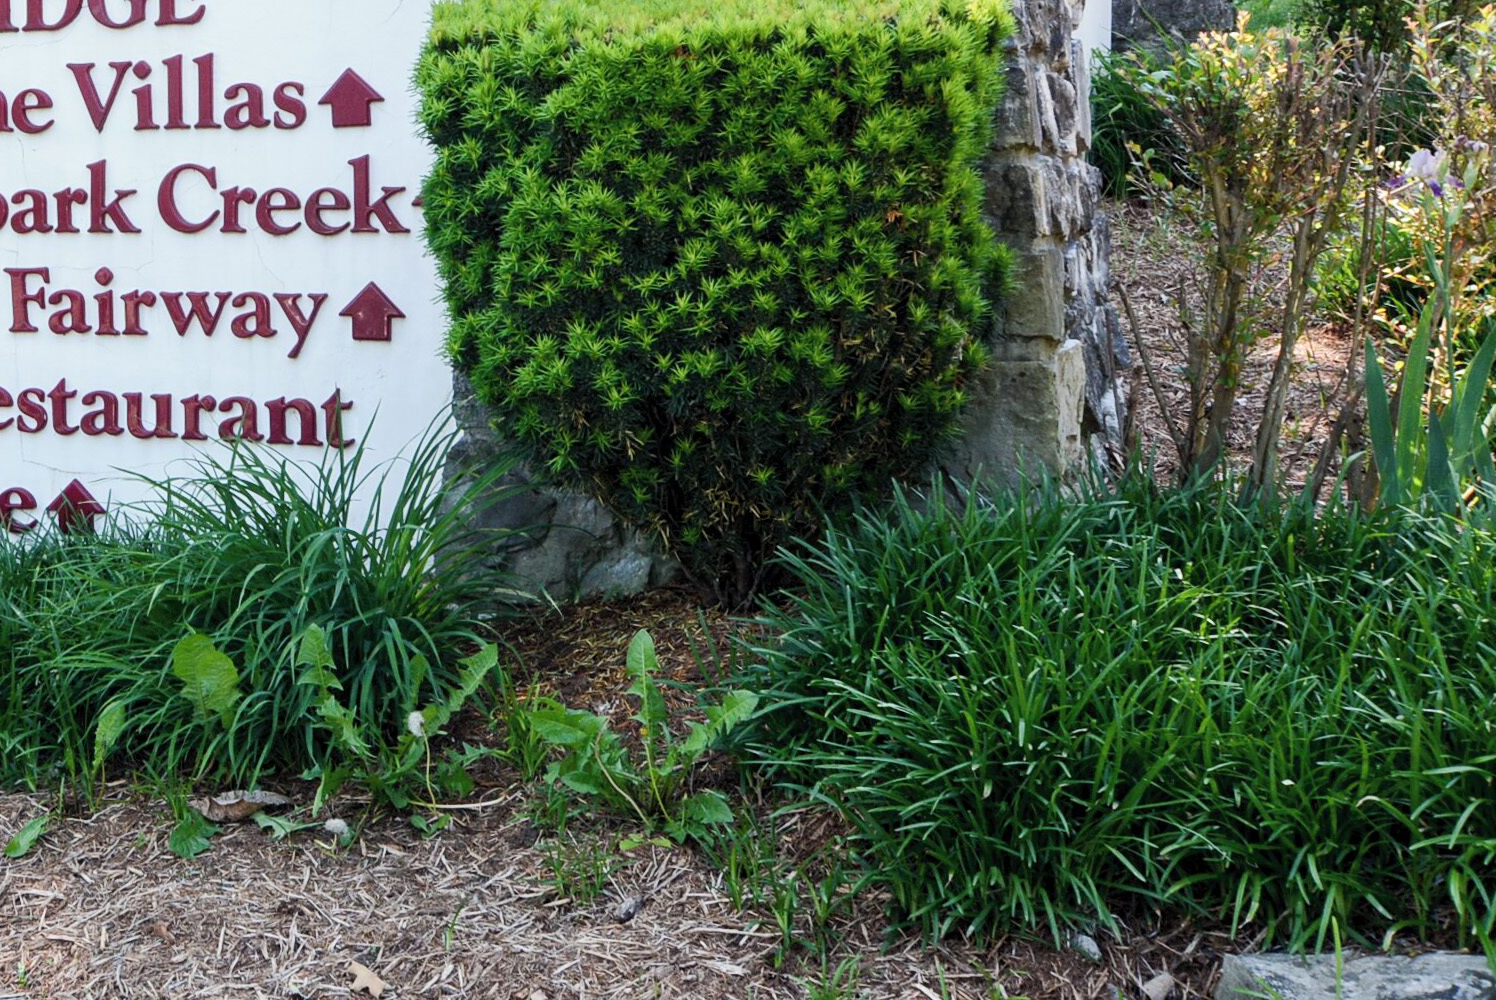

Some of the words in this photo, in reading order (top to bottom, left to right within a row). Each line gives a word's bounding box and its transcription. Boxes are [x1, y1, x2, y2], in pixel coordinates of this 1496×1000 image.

[66, 51, 307, 131] Villas
[156, 154, 411, 235] Creek
[3, 266, 328, 359] Fairway
